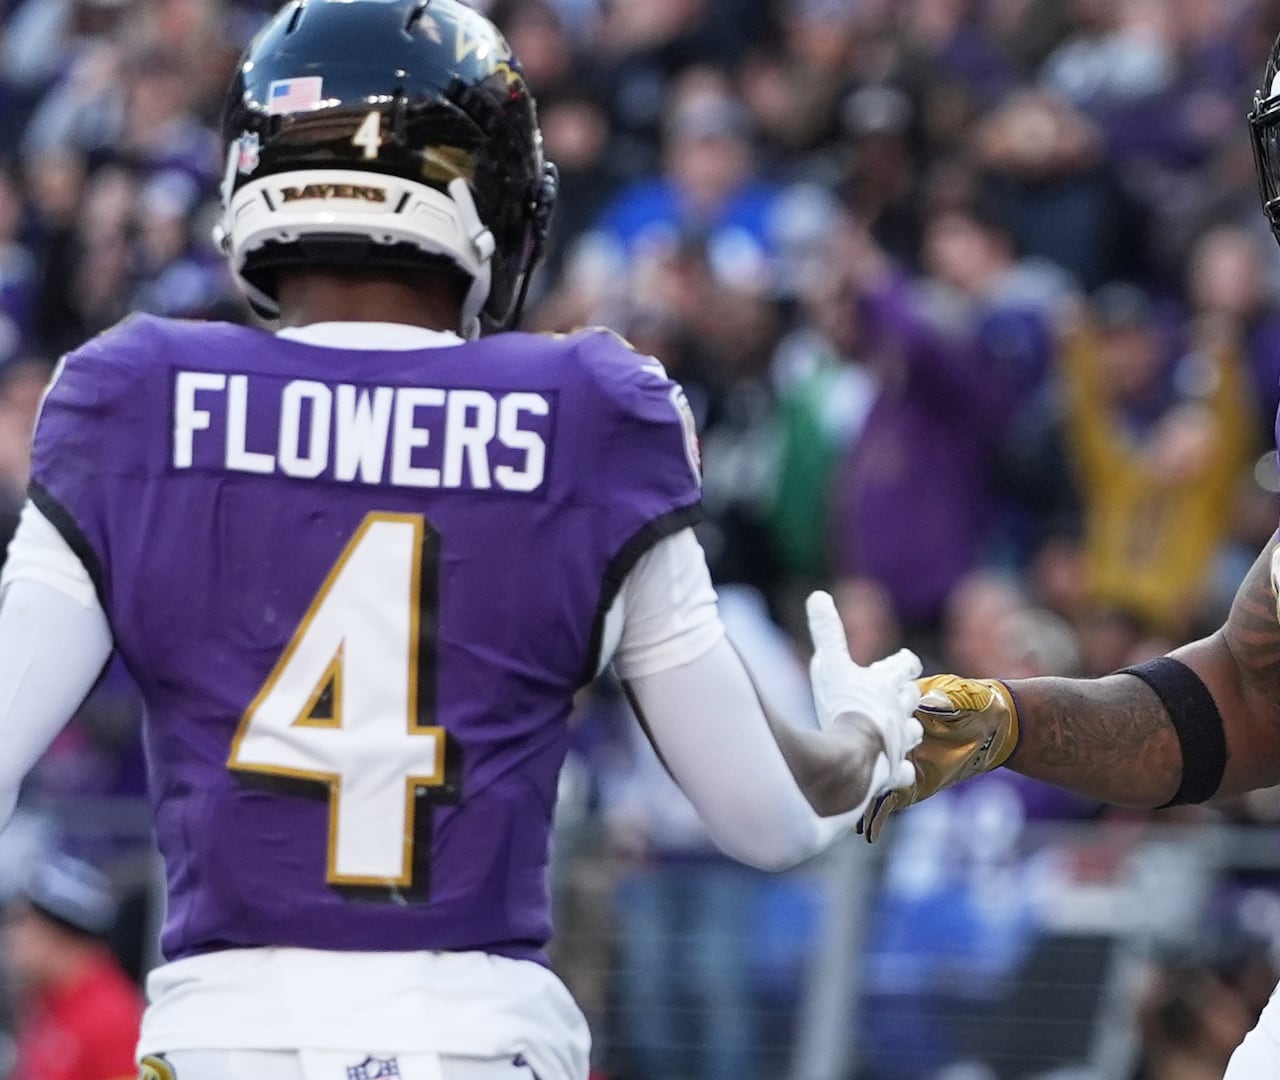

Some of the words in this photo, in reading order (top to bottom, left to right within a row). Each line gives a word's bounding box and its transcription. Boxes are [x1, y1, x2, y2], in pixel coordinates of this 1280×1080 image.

[352, 111, 382, 159] 4
[281, 184, 387, 203] RAVENS
[173, 370, 549, 492] FLOWERS
[226, 510, 457, 894] 4
